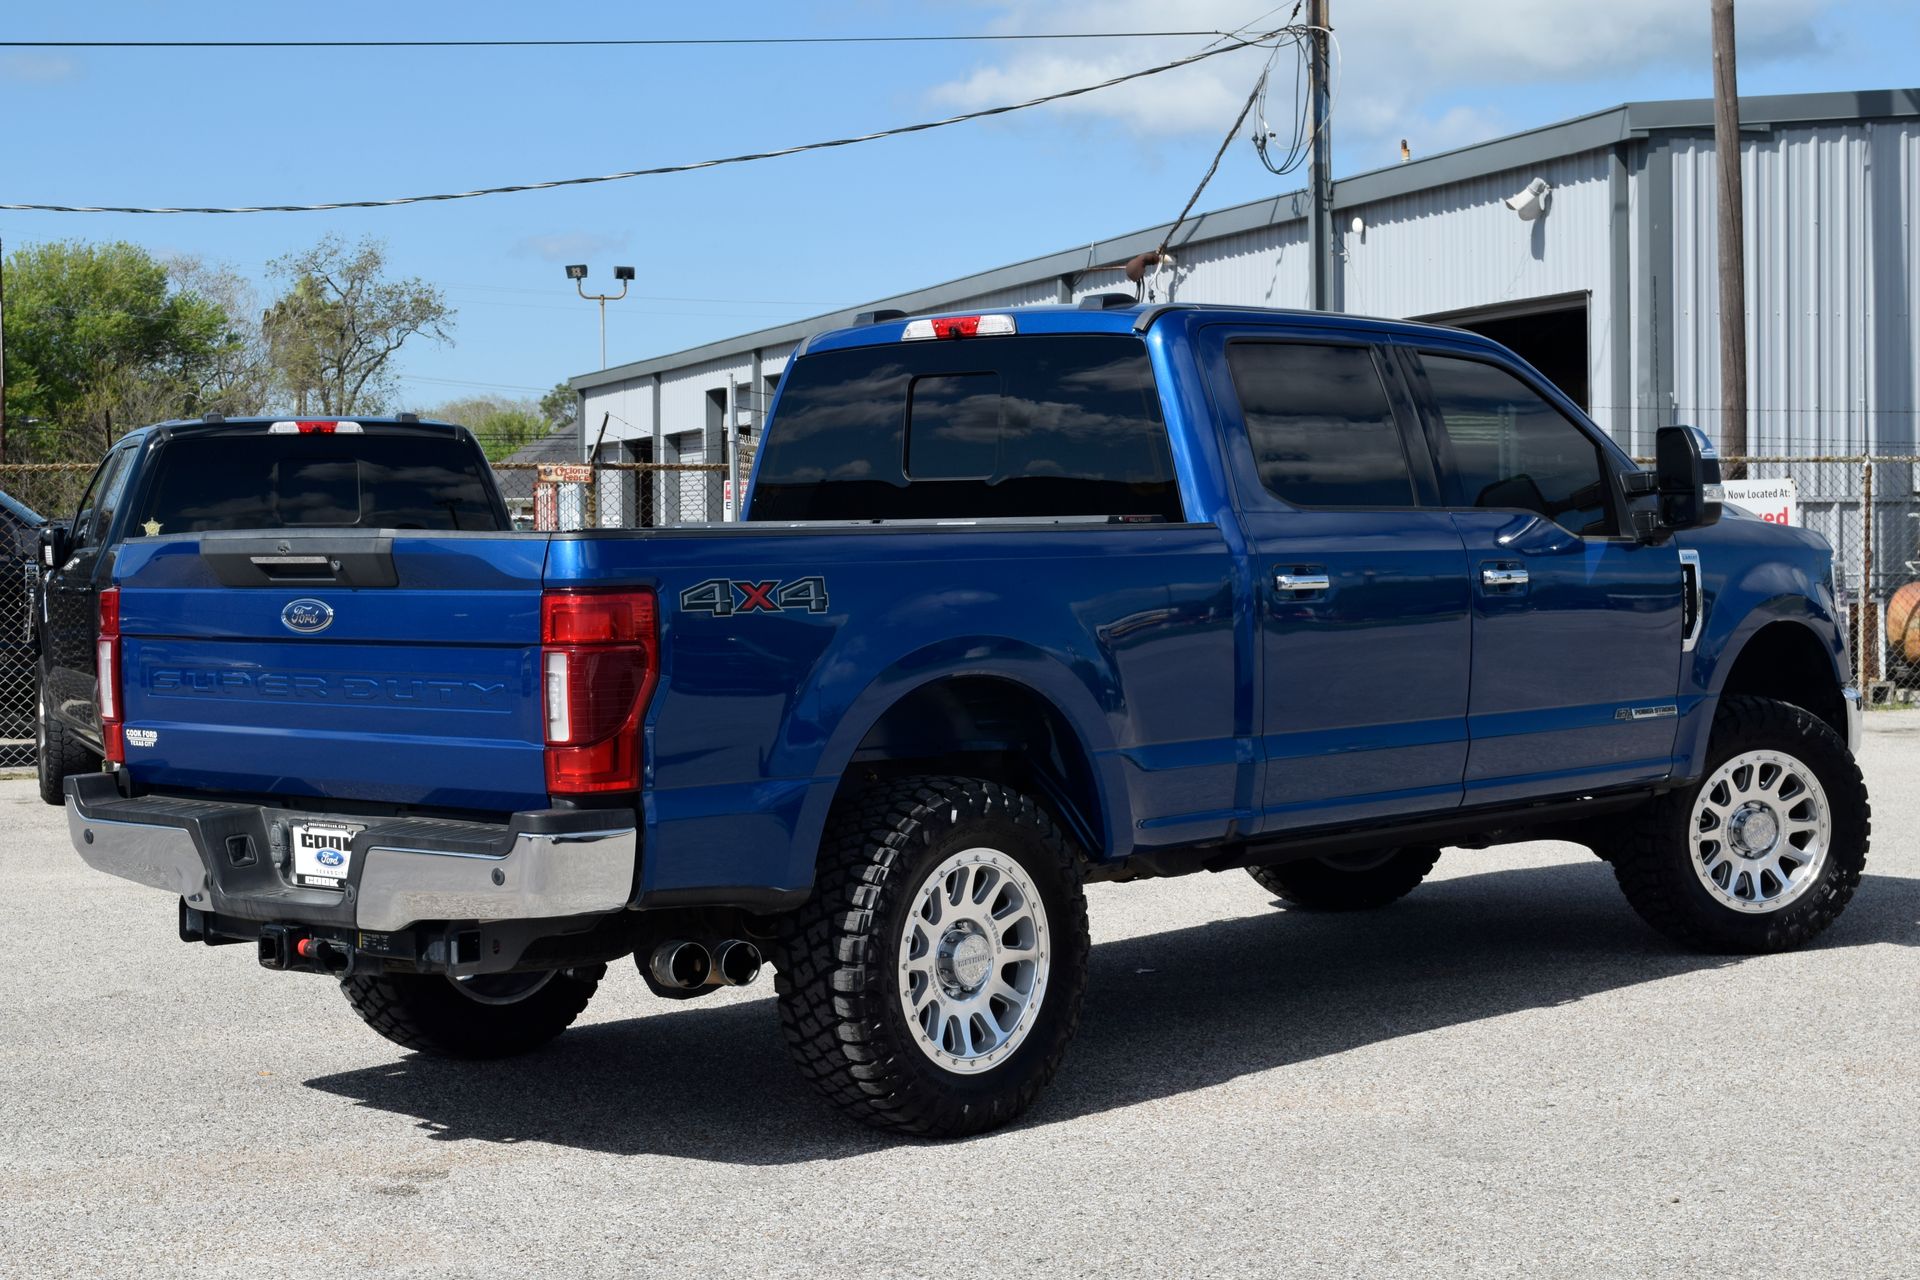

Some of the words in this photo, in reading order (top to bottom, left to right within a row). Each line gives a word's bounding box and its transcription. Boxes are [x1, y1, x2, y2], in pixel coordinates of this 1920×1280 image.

[555, 466, 590, 477] Cyclone
[1728, 490, 1746, 500] Now
[1748, 488, 1778, 499] Located
[1779, 488, 1791, 498] At:
[152, 670, 328, 699] SUPER
[342, 677, 506, 706] DUTY
[126, 729, 141, 737] COOK
[142, 730, 158, 738] FORD
[301, 833, 354, 851] COOK
[320, 851, 339, 865] Ford
[305, 875, 338, 887] COOK
